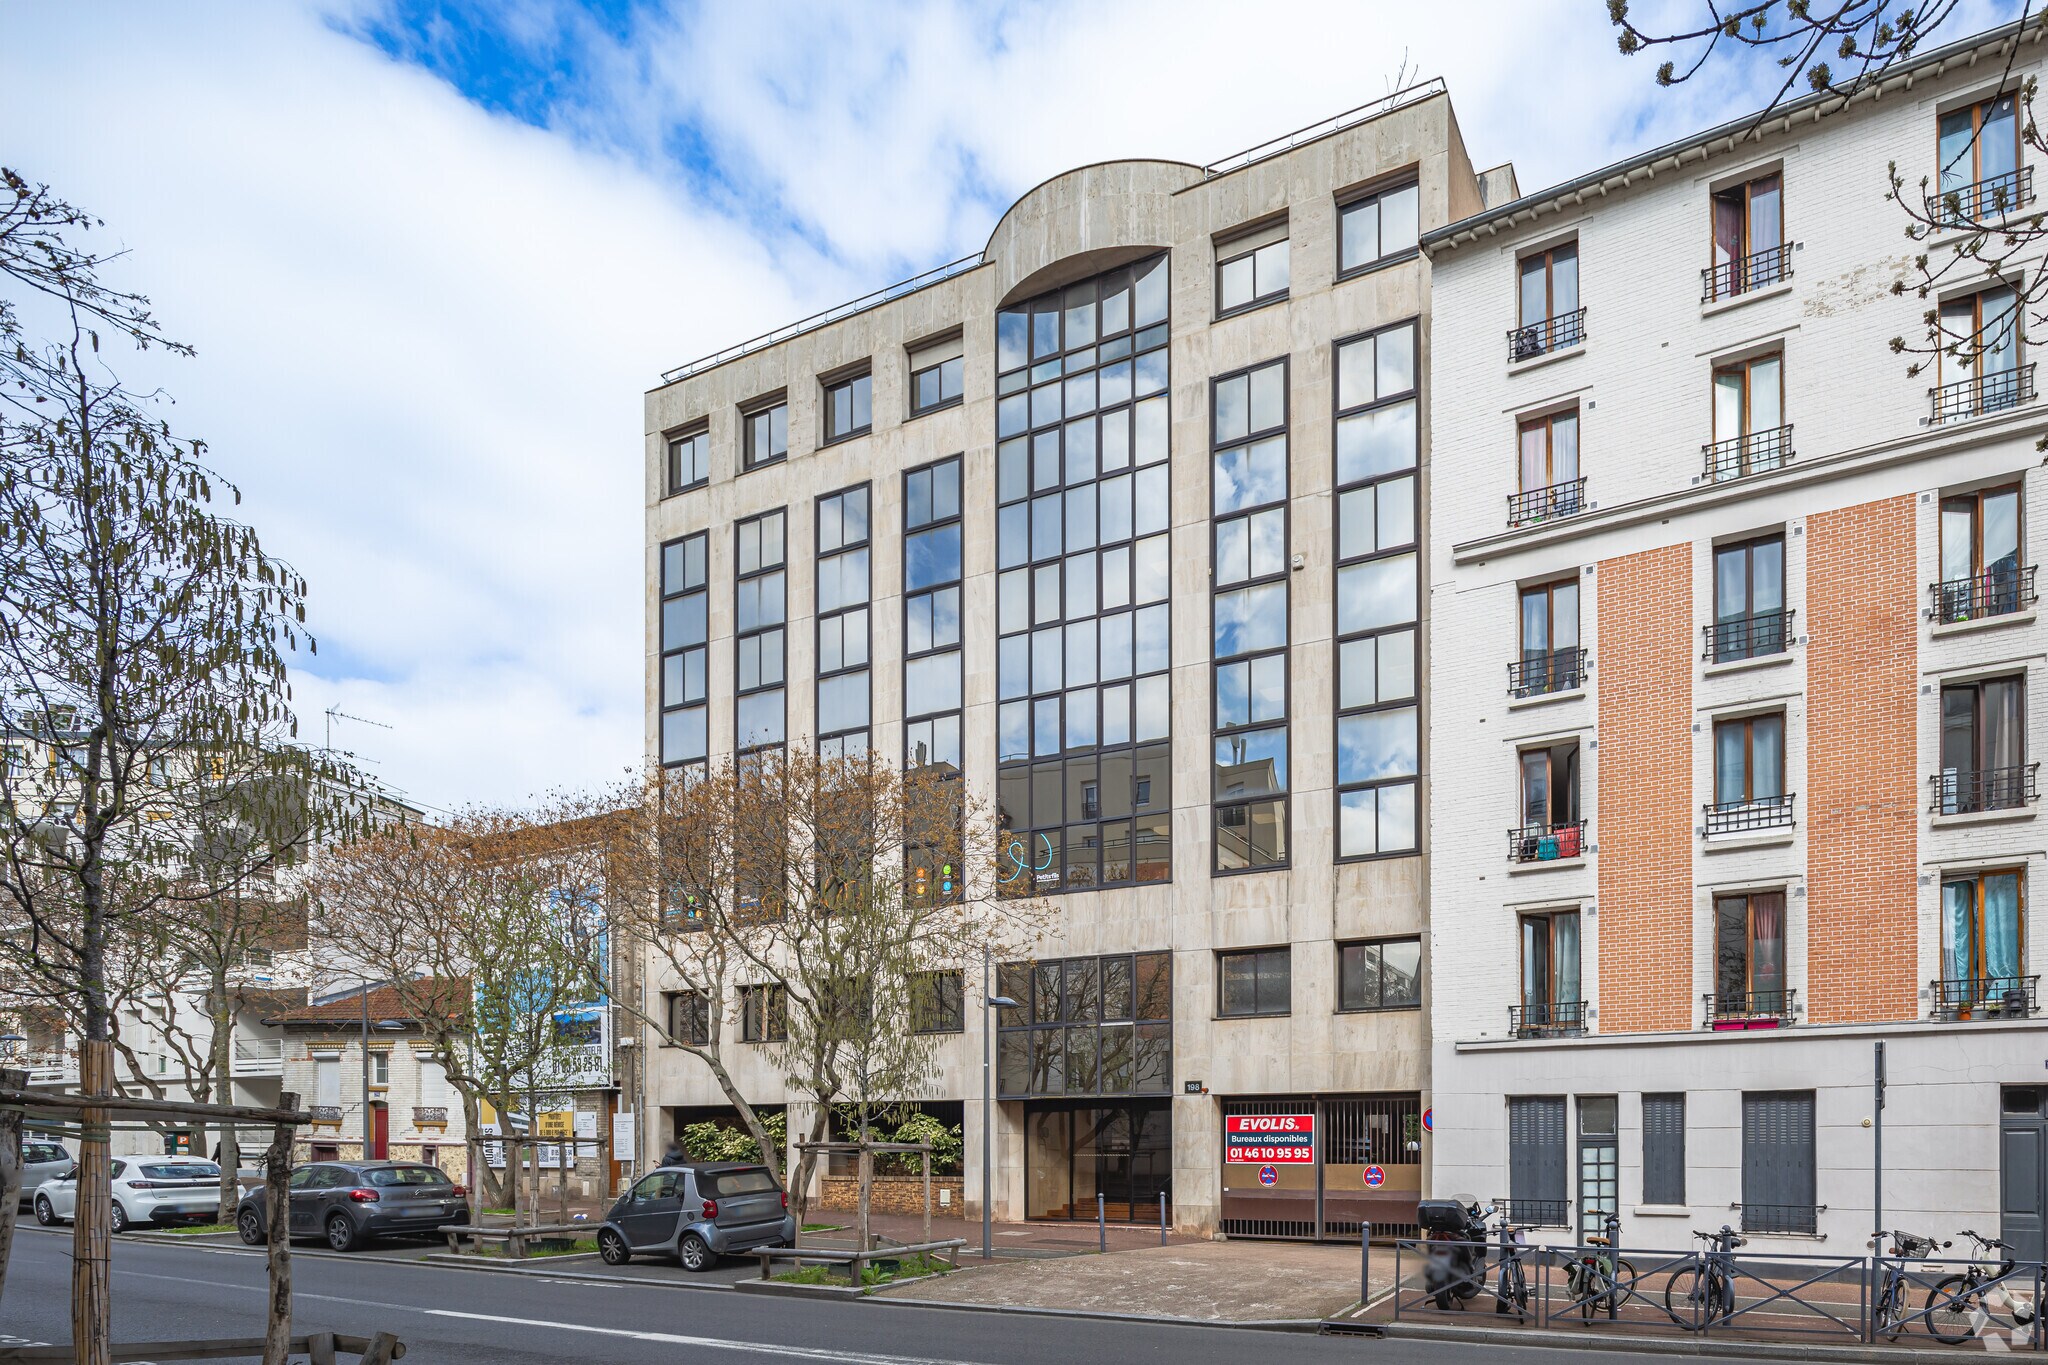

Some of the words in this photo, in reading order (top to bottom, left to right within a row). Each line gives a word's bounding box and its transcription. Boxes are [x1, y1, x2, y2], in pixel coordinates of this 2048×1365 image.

[1187, 1083, 1200, 1091] 198
[1231, 1135, 1262, 1143] Bureaux
[1263, 1134, 1308, 1144] disponibles
[484, 1128, 494, 1165] QUARTS
[1230, 1148, 1243, 1159] 01
[1244, 1148, 1259, 1159] 46
[1261, 1148, 1275, 1159] 10
[1276, 1148, 1292, 1159] 95
[1294, 1148, 1309, 1159] 95
